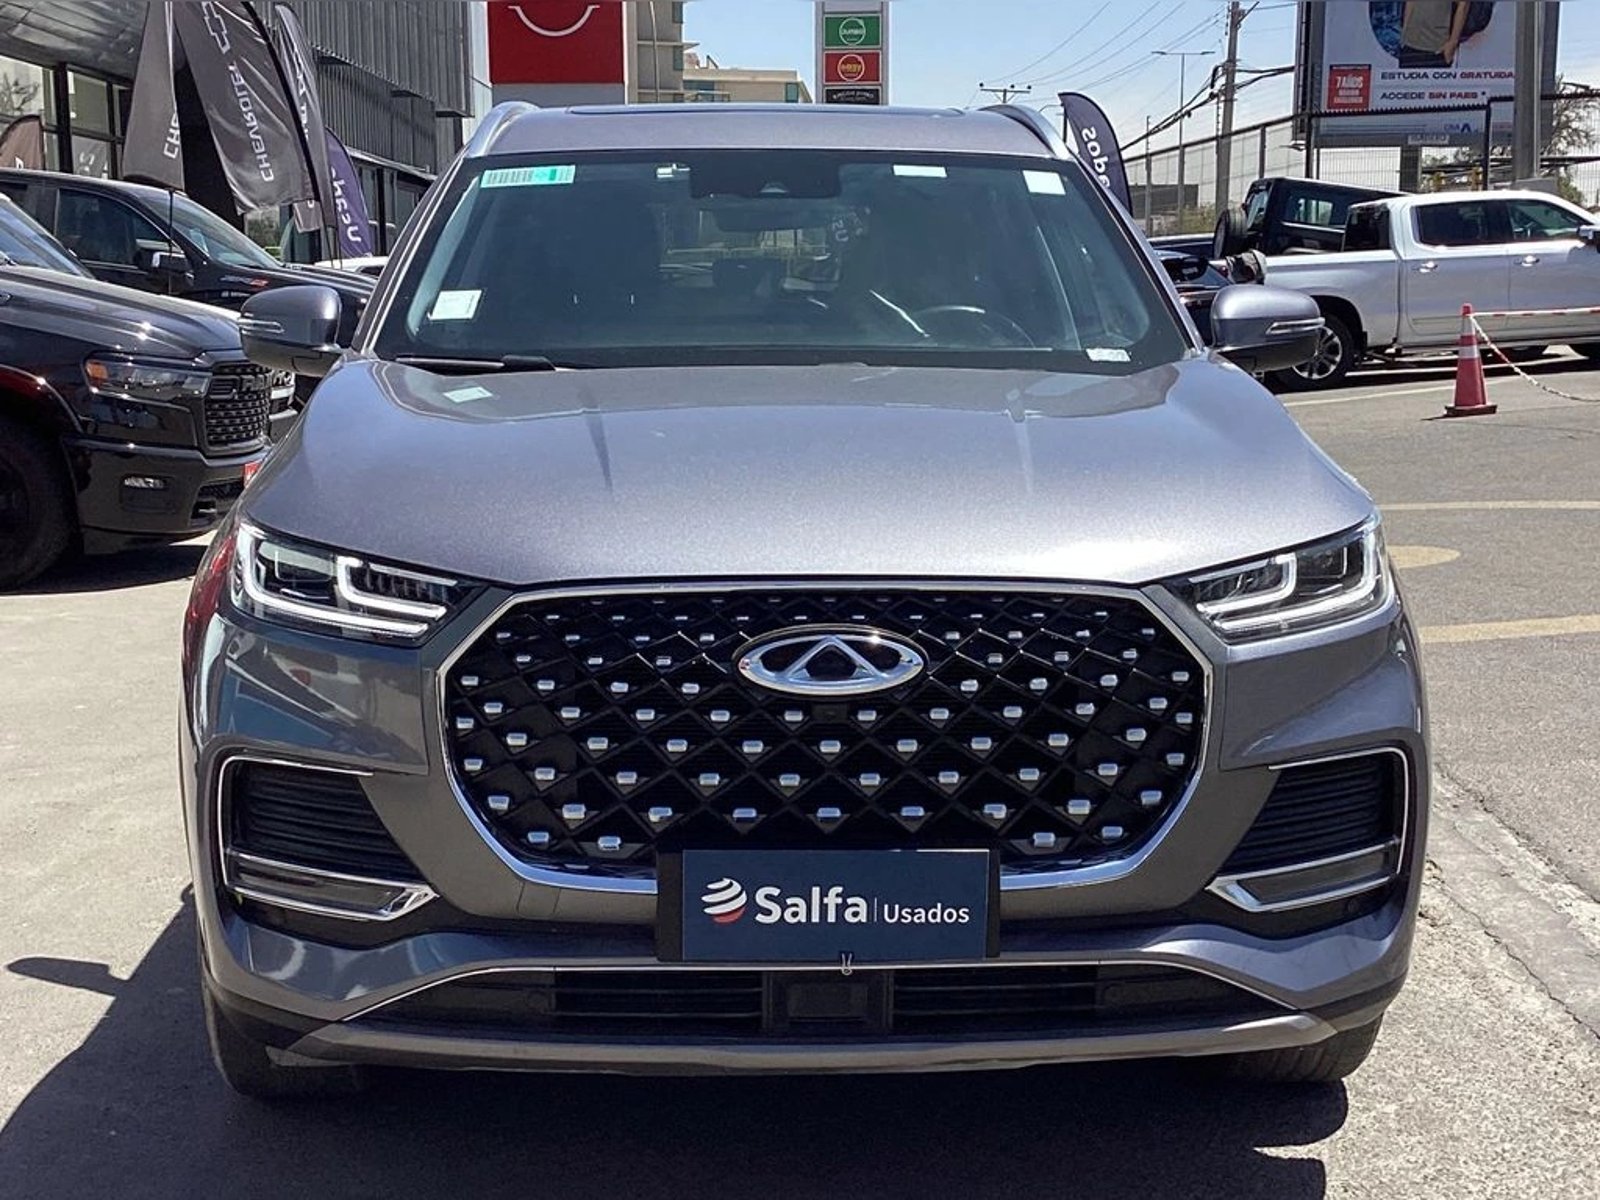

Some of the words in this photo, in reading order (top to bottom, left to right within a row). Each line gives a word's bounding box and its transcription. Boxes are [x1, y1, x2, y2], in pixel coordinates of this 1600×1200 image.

[1381, 72, 1429, 81] ESTUDIA
[1432, 72, 1457, 80] CON
[1380, 92, 1425, 100] ACCEDE
[1428, 91, 1447, 100] SIN
[754, 885, 868, 925] Salfa
[883, 902, 971, 925] Usados
